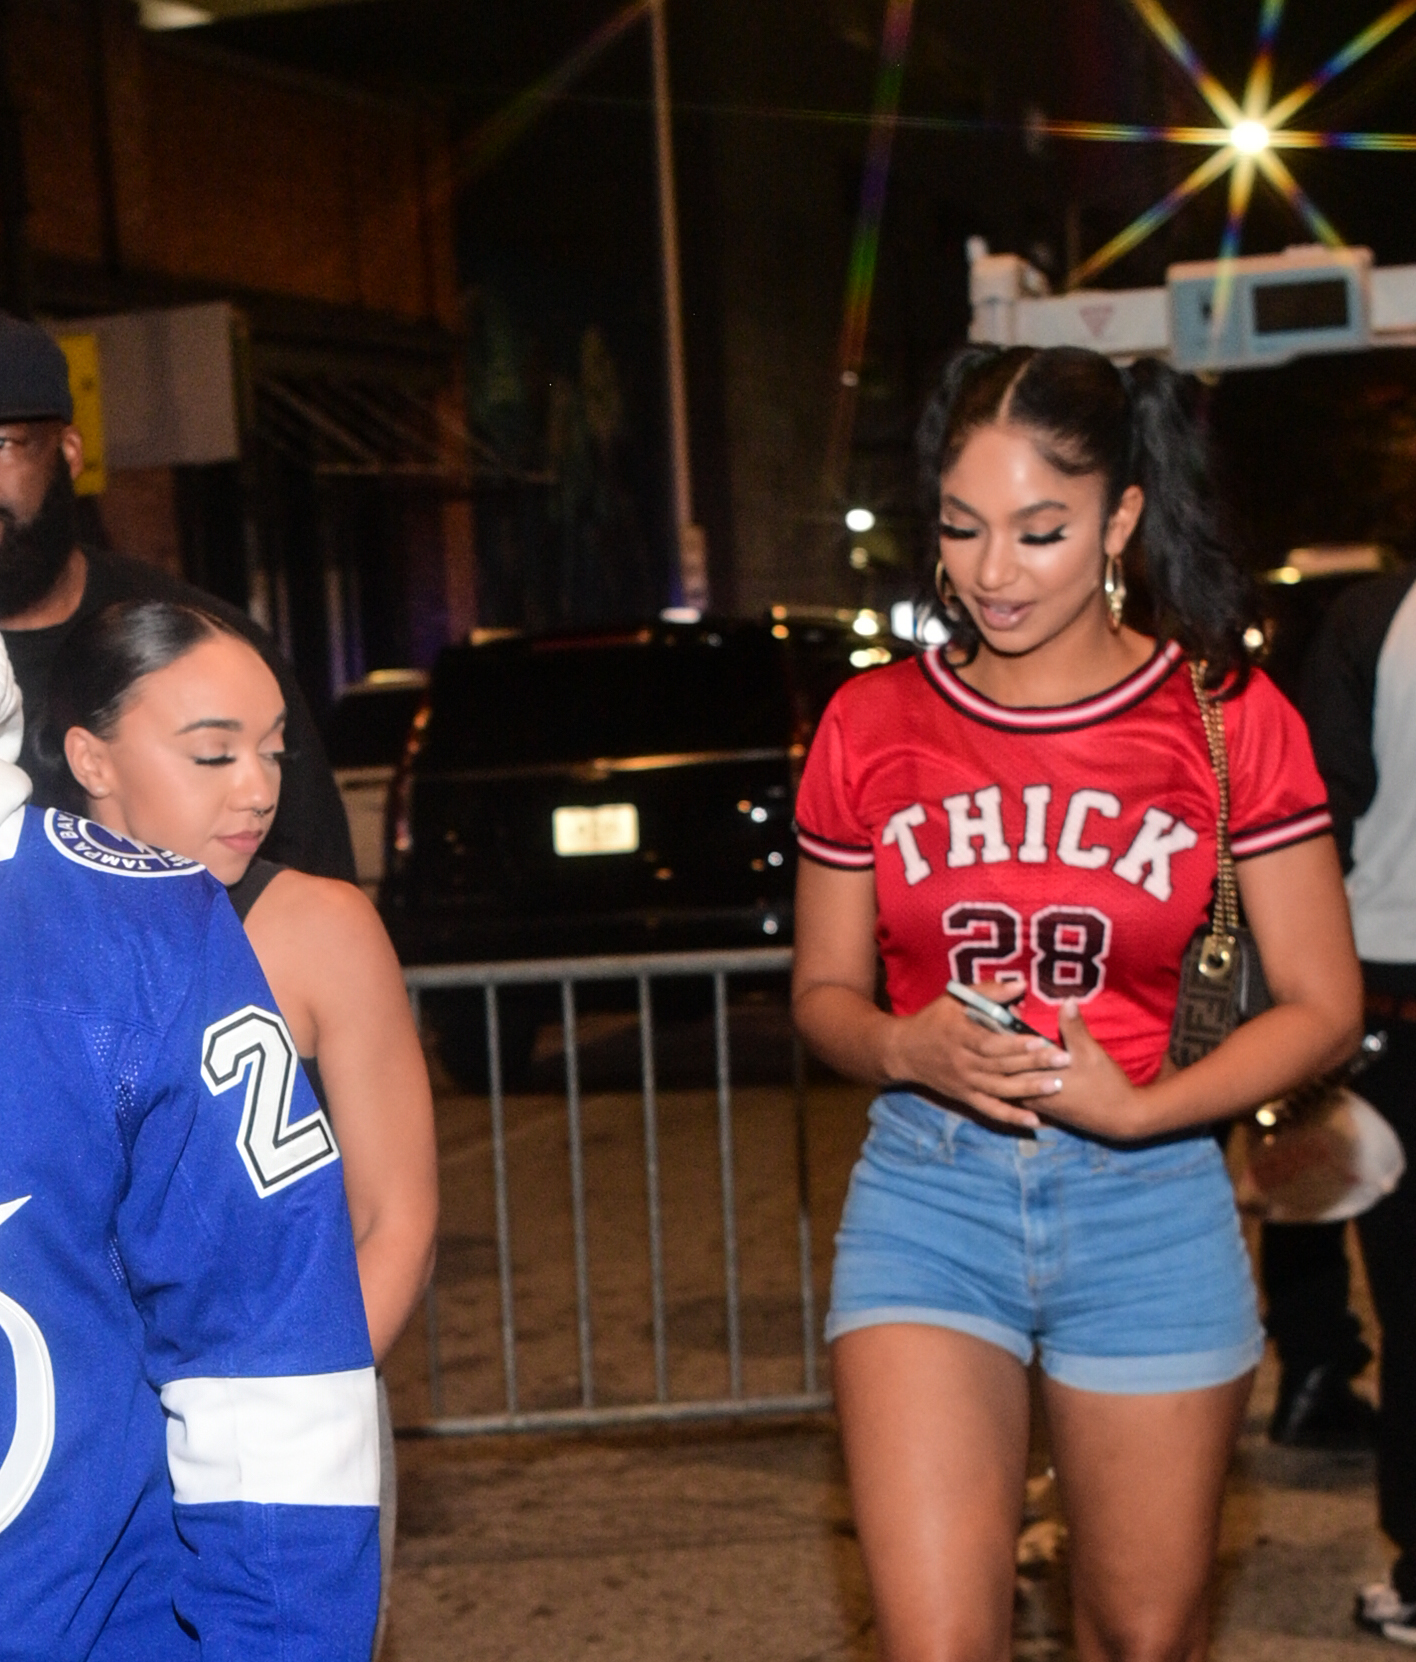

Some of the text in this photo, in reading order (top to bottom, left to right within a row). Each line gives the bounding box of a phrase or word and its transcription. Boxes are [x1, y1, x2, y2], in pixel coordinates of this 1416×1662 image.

[57, 813, 79, 840] BAY
[73, 841, 151, 870] TAMPA
[882, 784, 1198, 902] THICK
[942, 901, 1112, 1005] 28
[200, 1004, 341, 1199] 2
